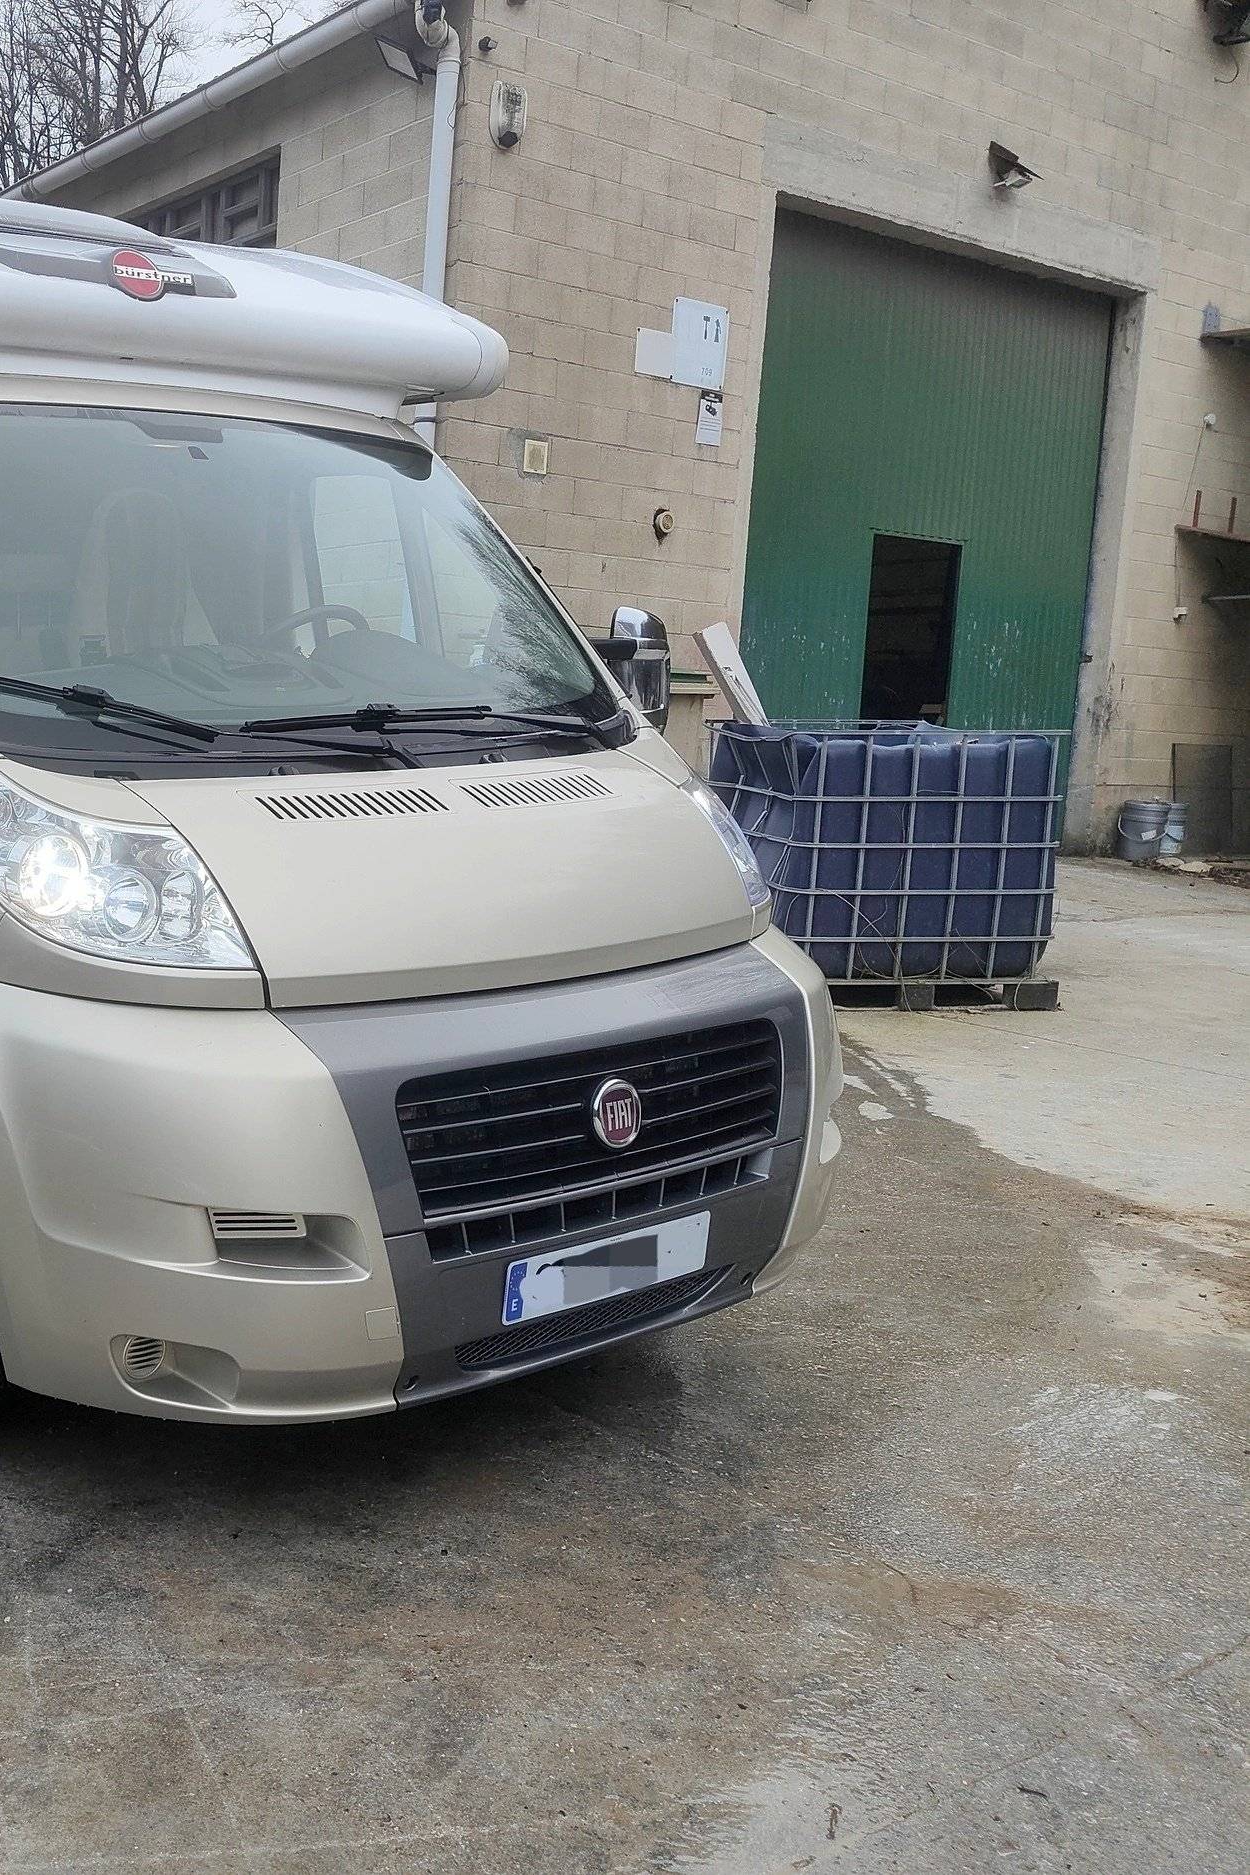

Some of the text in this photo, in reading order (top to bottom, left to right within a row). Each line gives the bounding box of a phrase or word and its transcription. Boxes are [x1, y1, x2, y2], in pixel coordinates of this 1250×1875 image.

[113, 265, 191, 284] bürstner
[605, 1097, 632, 1132] FIAT
[510, 1297, 518, 1312] E
